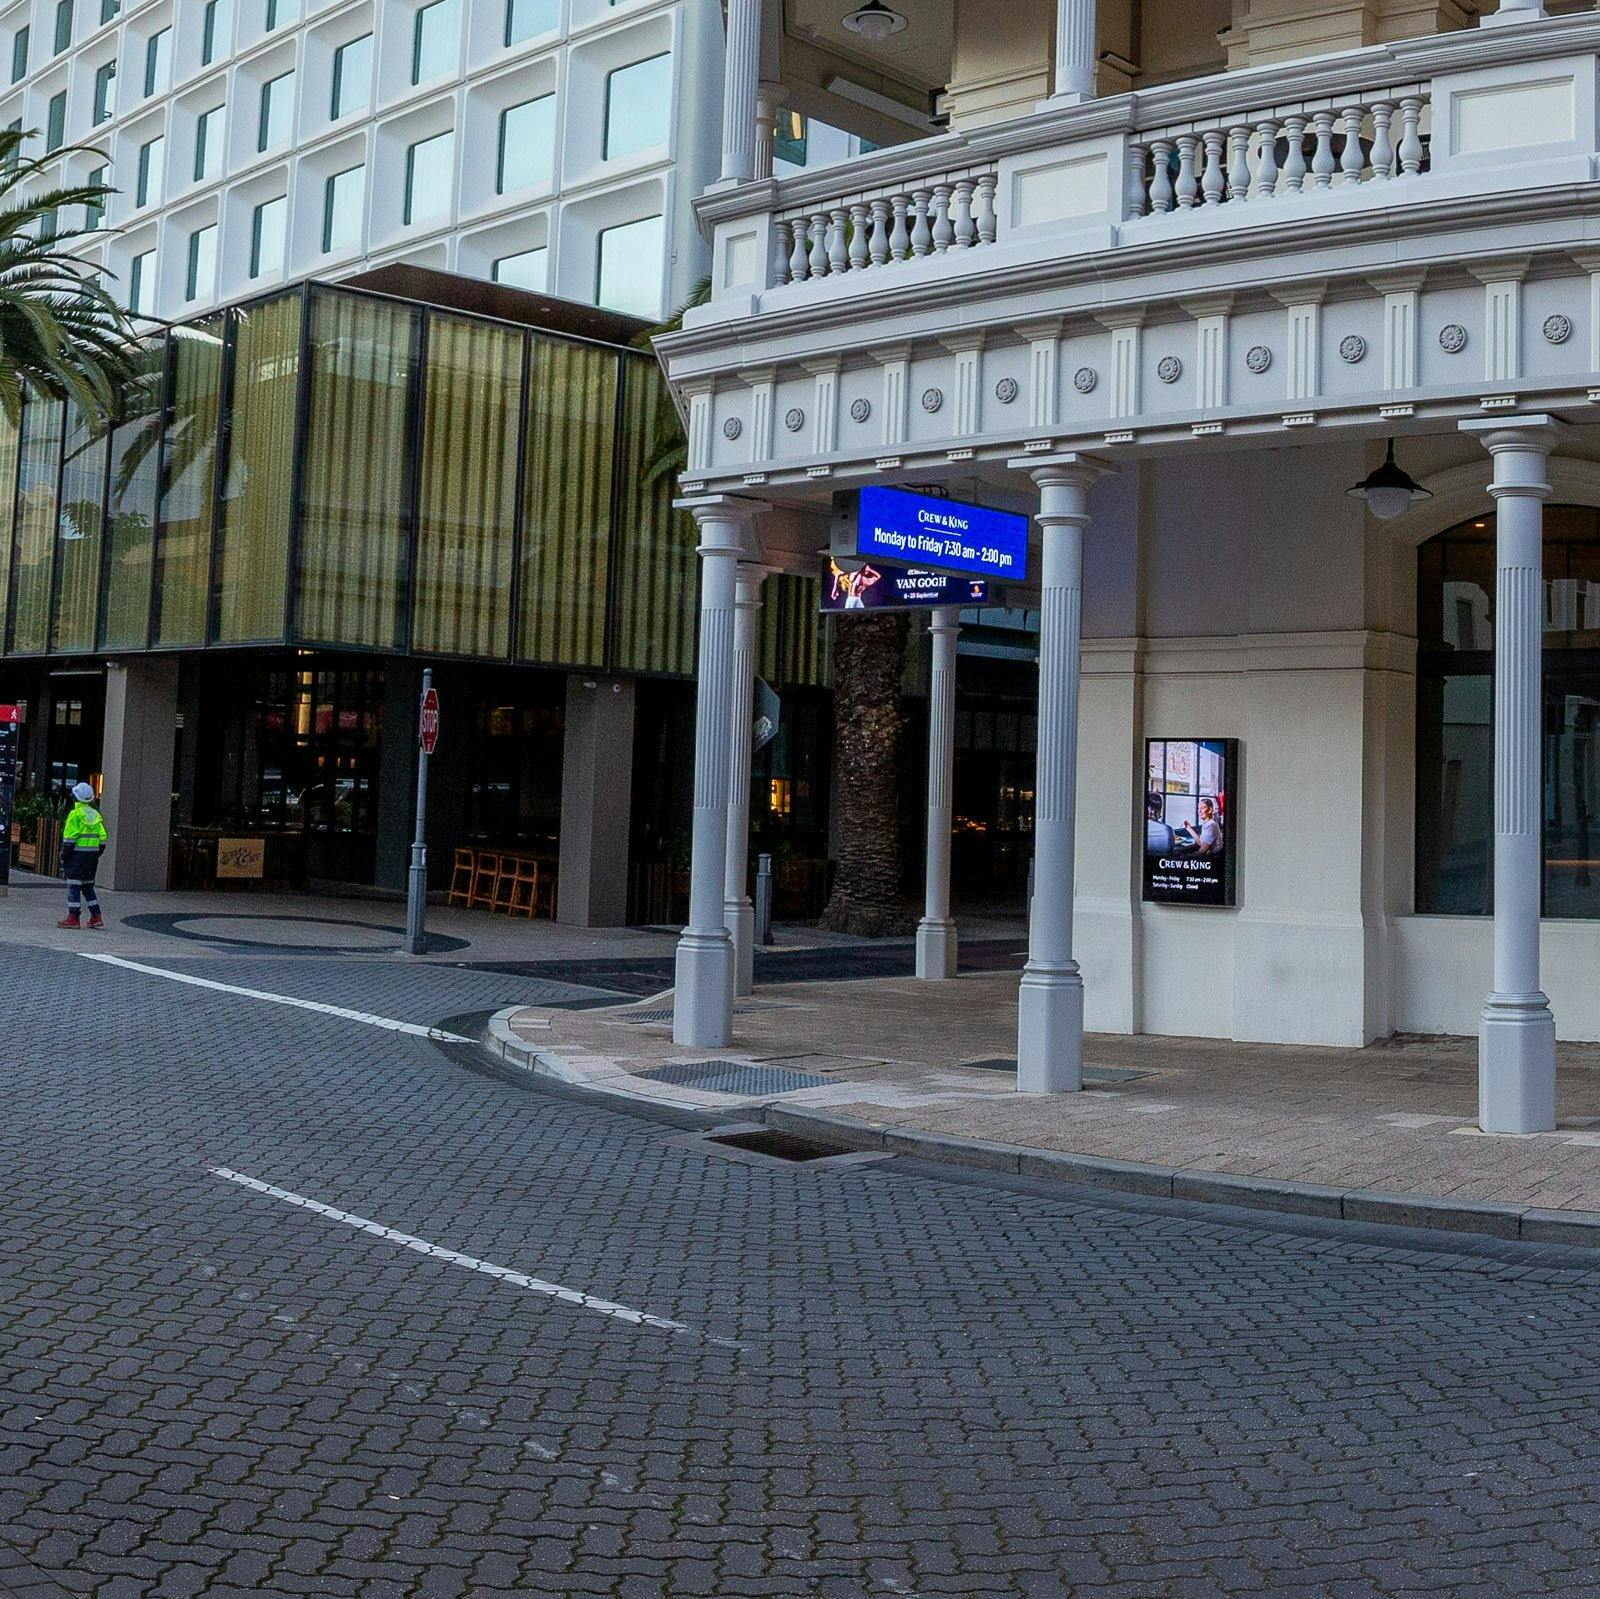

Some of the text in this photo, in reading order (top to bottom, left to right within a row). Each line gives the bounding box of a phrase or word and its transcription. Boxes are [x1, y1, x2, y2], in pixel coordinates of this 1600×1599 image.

[874, 527, 906, 549] Monday
[908, 536, 917, 549] to
[918, 536, 944, 556] Friday
[944, 540, 961, 557] 7:30
[962, 547, 975, 559] am
[981, 547, 998, 564] 2:00
[1000, 552, 1012, 568] pm
[896, 577, 947, 589] VAN GOGH
[423, 709, 438, 733] STOP
